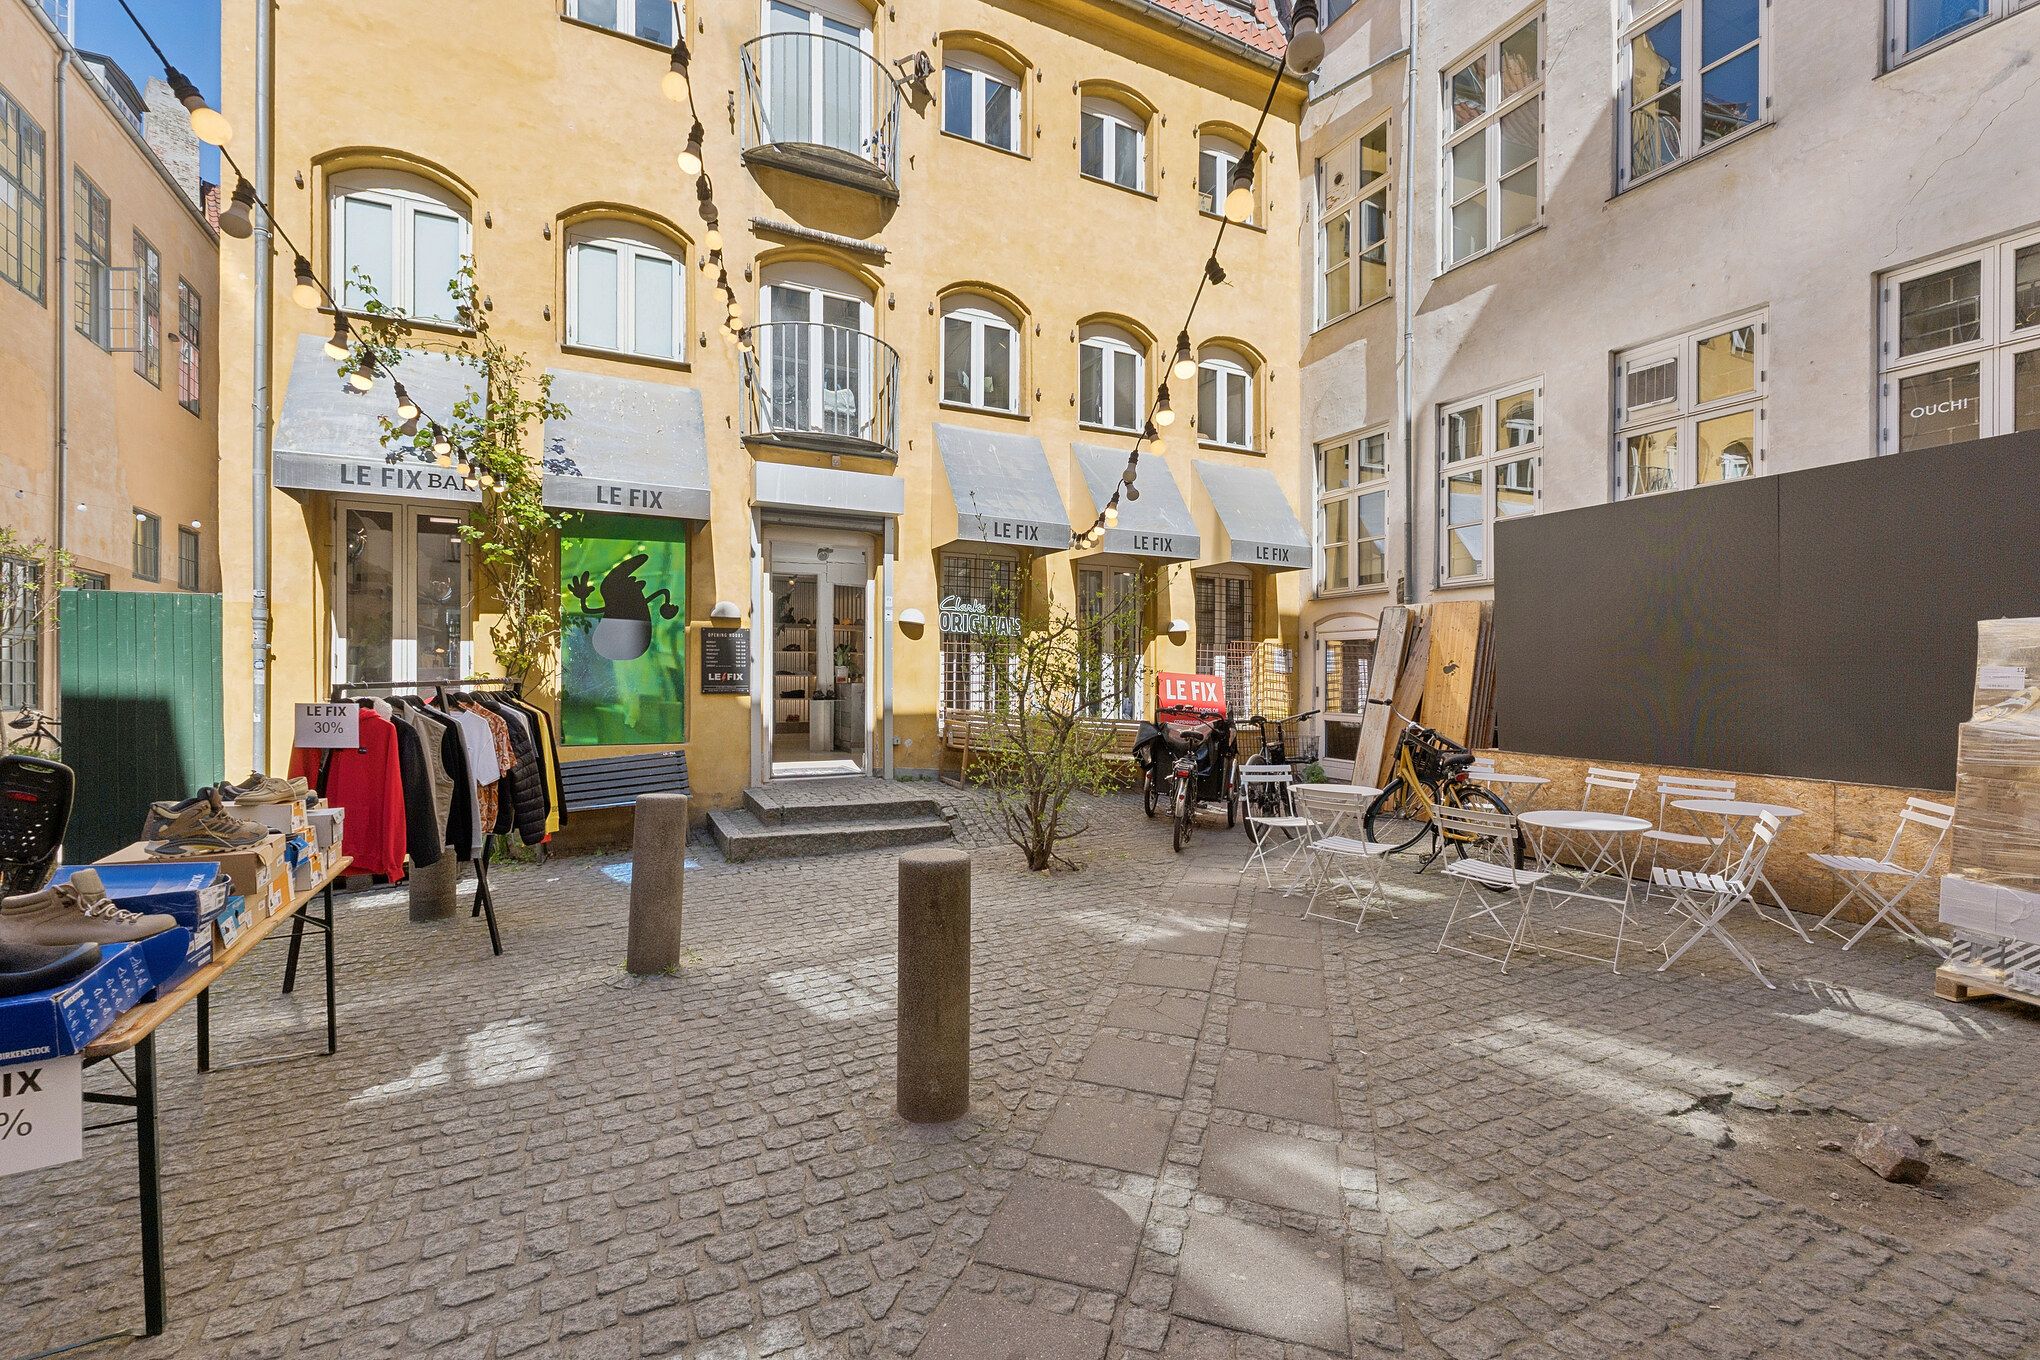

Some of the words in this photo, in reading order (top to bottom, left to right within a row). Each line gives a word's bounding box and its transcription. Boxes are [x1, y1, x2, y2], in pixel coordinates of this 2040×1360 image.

[1910, 398, 1968, 418] OUCH!
[340, 463, 372, 486] LE
[381, 467, 423, 491] FIX
[597, 485, 622, 506] LE
[629, 488, 663, 510] FIX
[994, 521, 1011, 538] LE
[1016, 524, 1039, 541] FIX
[1134, 535, 1149, 550] LE
[1152, 536, 1173, 552] FIX
[1256, 546, 1269, 560] LE
[1272, 547, 1289, 562] FIX
[939, 594, 987, 613] Clarks
[938, 611, 1022, 637] ORIGINALS
[708, 672, 721, 681] LE
[726, 672, 744, 681] FIX
[1165, 679, 1187, 701] LE
[1190, 680, 1219, 702] FIX
[306, 706, 322, 717] LE
[325, 706, 347, 717] FIX
[314, 721, 344, 734] 30%
[2, 1067, 43, 1098] IX
